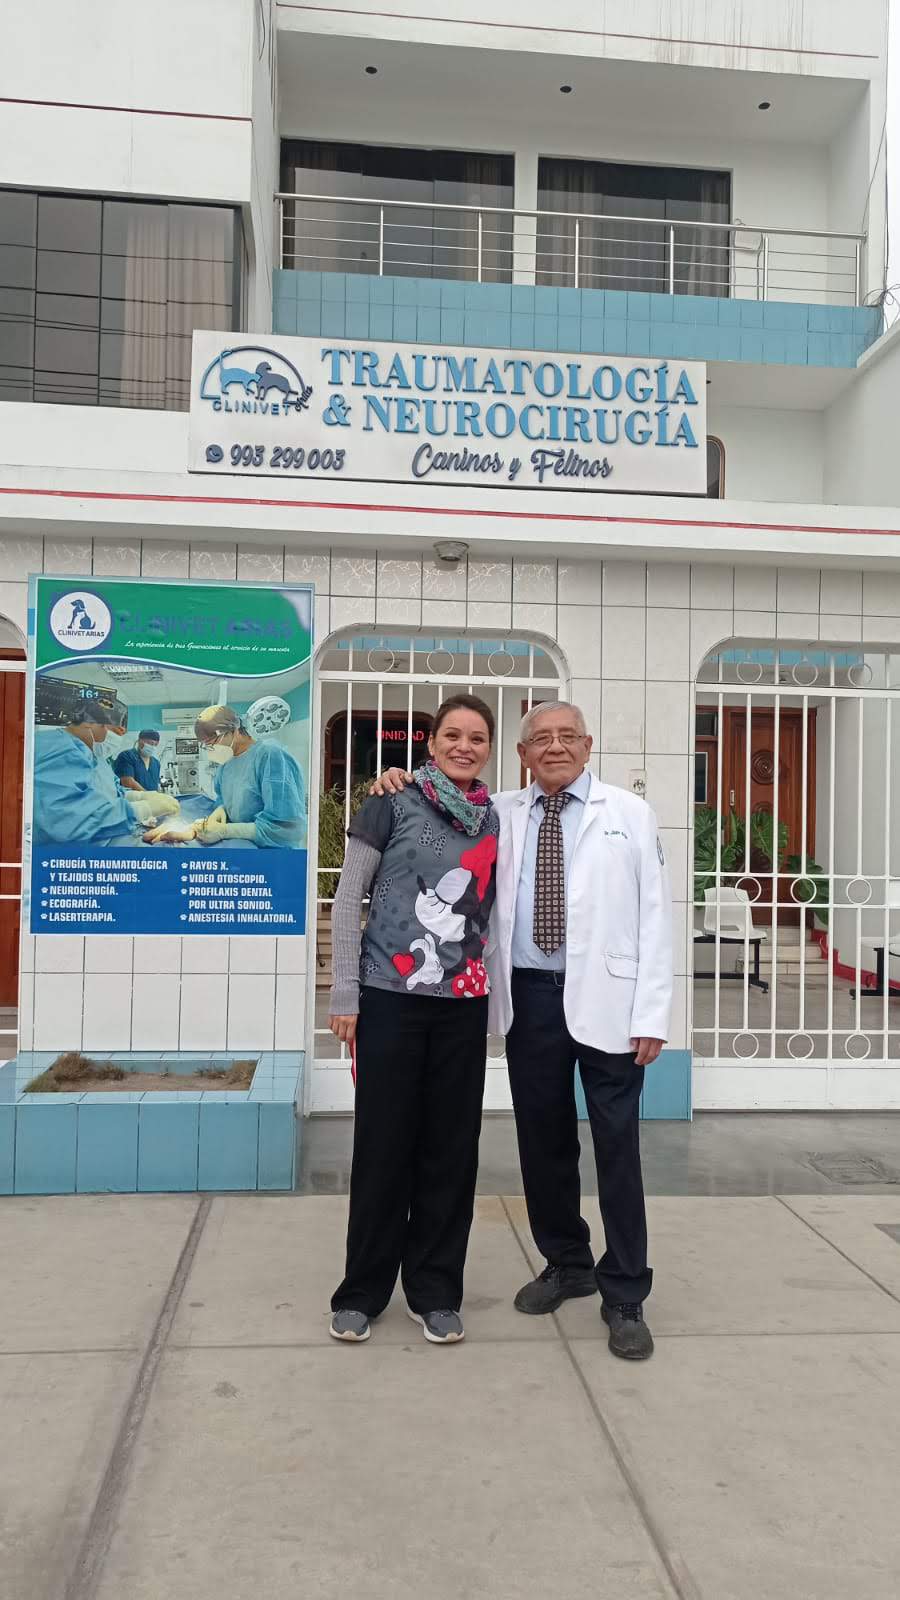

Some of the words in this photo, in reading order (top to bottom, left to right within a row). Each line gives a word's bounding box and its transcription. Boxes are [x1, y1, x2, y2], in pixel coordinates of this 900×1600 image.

[321, 347, 698, 405] TRAUMATOLOGÍA
[212, 399, 291, 416] CLINIVET
[322, 393, 352, 427] &
[362, 394, 699, 448] NEUROCIRUGÍA
[230, 444, 265, 467] 993
[270, 446, 305, 469] 299
[307, 448, 346, 471] 003
[412, 442, 504, 478] Caninos
[508, 457, 522, 481] y
[50, 858, 87, 869] CIRUGÍA
[89, 858, 168, 870] TRAUMATOLÓGICA
[189, 861, 218, 871] RAYOS
[220, 861, 229, 871] X.
[50, 873, 56, 882] Y
[58, 872, 94, 882] TEJIDOS
[96, 873, 141, 883] BLANDOS.
[189, 874, 214, 884] VIDEO
[217, 874, 268, 884] OTOSCOPIO.
[49, 884, 119, 896] NEUROCIRUGÍA.
[189, 887, 239, 897] PROFILAXIS
[241, 887, 273, 898] DENTAL
[49, 897, 101, 909] ECOGRAFÍA.
[188, 900, 206, 910] POR
[208, 900, 235, 910] ULTRA
[237, 900, 274, 911] SONIDO.
[49, 912, 116, 922] LASERTERAPIA.
[188, 913, 235, 923] ANESTESIA
[237, 913, 297, 924] INHALATORIA.
